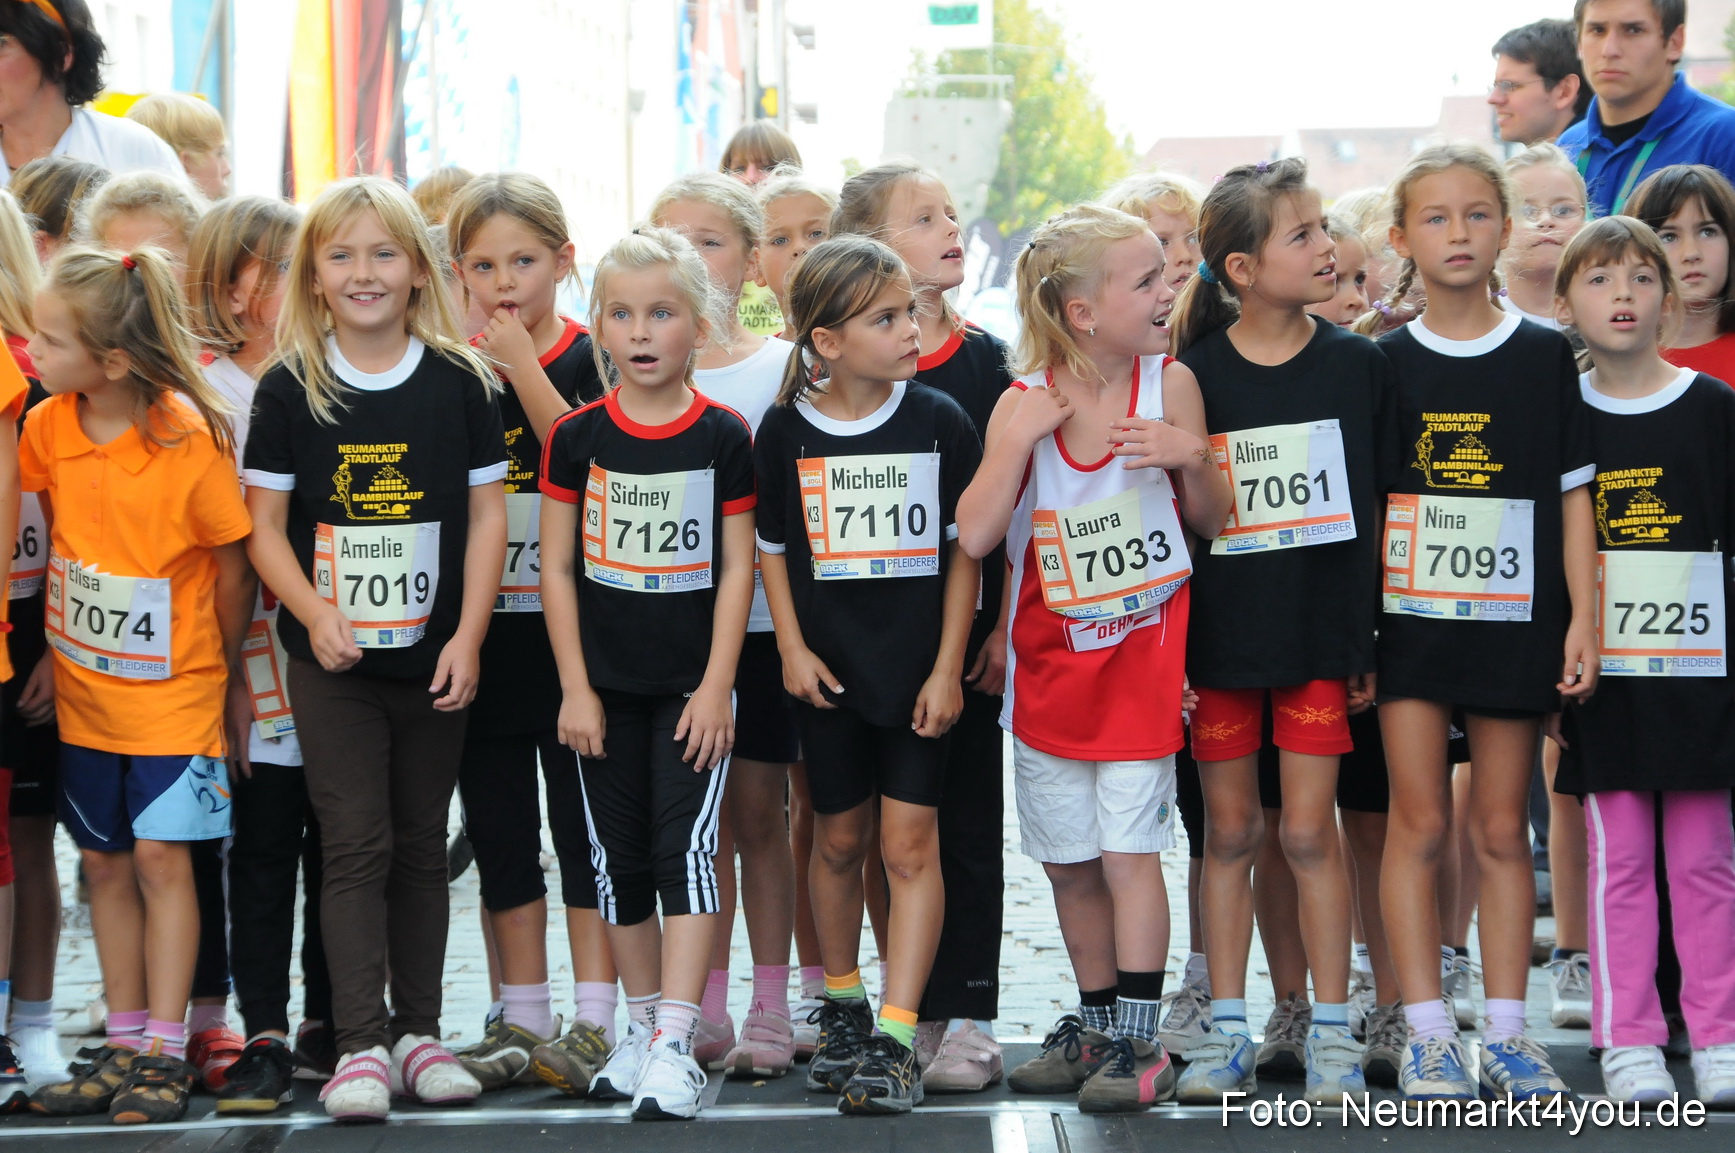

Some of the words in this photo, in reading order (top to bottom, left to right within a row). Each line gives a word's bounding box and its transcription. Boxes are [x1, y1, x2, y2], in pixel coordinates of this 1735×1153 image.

[1422, 412, 1491, 423] NEUMARKTER
[1426, 422, 1484, 432] STADTLAUF
[338, 443, 408, 454] NEUMARKTER
[1235, 440, 1278, 465] Alina
[343, 453, 402, 464] STADTLAUF
[1432, 461, 1504, 472] BAMBINILAUF
[831, 465, 908, 490] Michelle
[1596, 467, 1663, 482] NEUMARKTER
[1240, 469, 1330, 512] 7061
[1600, 477, 1657, 491] STADTLAUF
[351, 491, 424, 502] BAMBINILAUF
[611, 481, 670, 511] Sidney
[586, 507, 598, 526] K3
[806, 505, 819, 523] K3
[834, 503, 927, 539] 7110
[1425, 505, 1466, 530] Nina
[1609, 514, 1682, 528] BAMBINILAUF
[1064, 512, 1121, 539] Laura
[1295, 521, 1352, 538] PFLEIDERER
[612, 518, 700, 553] 7126
[341, 536, 403, 559] Amelie
[1076, 530, 1172, 583] 7033
[1390, 539, 1407, 557] K3
[887, 556, 937, 568] PFLEIDERER
[1041, 554, 1060, 571] K3
[1426, 544, 1520, 579] 7093
[68, 561, 100, 592] Elisa
[317, 568, 329, 587] K3
[661, 569, 710, 585] PFLEIDERER
[49, 578, 60, 601] K3
[343, 571, 430, 607] 7019
[1474, 601, 1529, 612] PFLEIDERER
[70, 596, 155, 642] 7074
[1614, 602, 1710, 635] 7225
[110, 659, 166, 673] PFLEIDERER
[1666, 657, 1723, 668] PFLEIDERER
